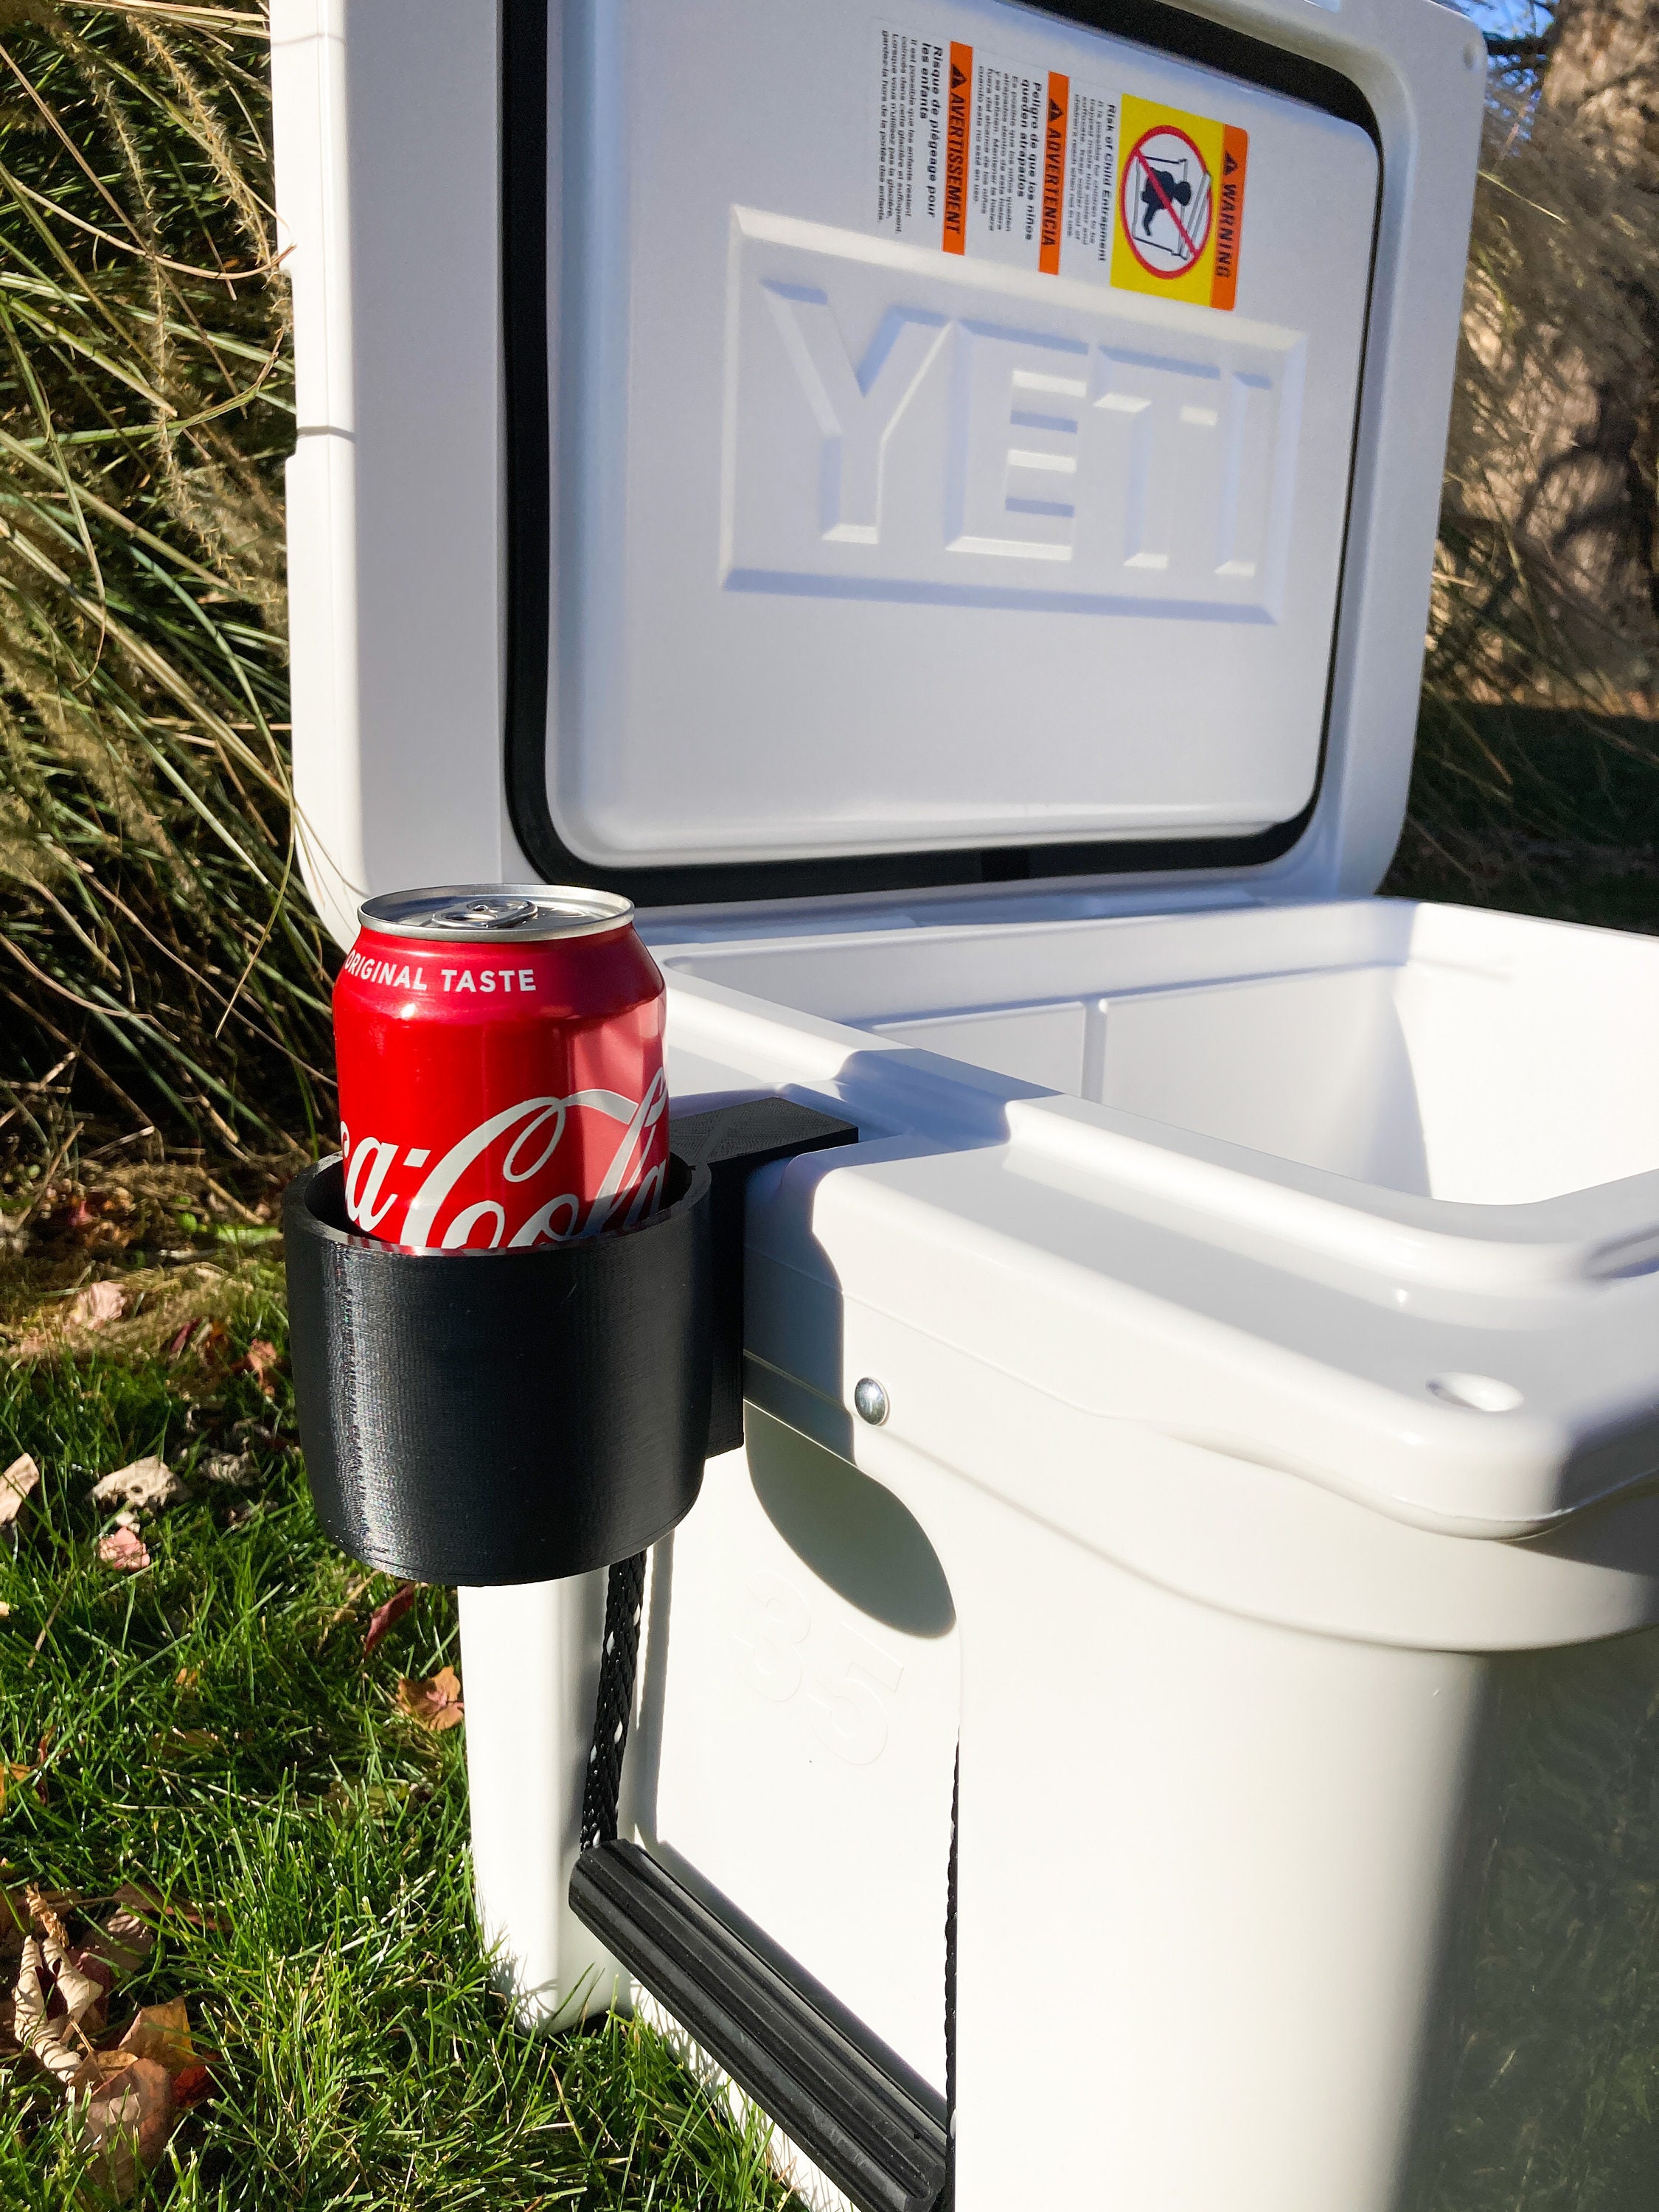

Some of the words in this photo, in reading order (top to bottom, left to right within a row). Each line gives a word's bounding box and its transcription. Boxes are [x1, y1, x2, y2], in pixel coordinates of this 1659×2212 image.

[921, 42, 932, 63] les
[931, 46, 943, 94] Risque
[919, 67, 930, 119] enfants
[931, 98, 941, 116] de
[1020, 78, 1031, 128] queden
[1029, 82, 1042, 129] Peligro
[1106, 103, 1116, 131] Risk
[927, 119, 939, 181] piégeage
[945, 93, 965, 232] AVERTISSEMENT
[1029, 133, 1039, 149] de
[1104, 136, 1113, 150] of
[1017, 132, 1028, 197] atrapados
[1026, 153, 1036, 177] que
[1041, 128, 1061, 245] ADVERTENCIA
[1102, 152, 1113, 186] Child
[925, 185, 936, 217] pour
[1026, 180, 1037, 201] los
[1024, 204, 1035, 240] niños
[1098, 189, 1110, 261] Entrapment
[1216, 184, 1237, 277] WARNING
[759, 278, 1274, 579] YETI
[344, 949, 428, 991] ORIGINAL
[441, 969, 537, 993] TASTE
